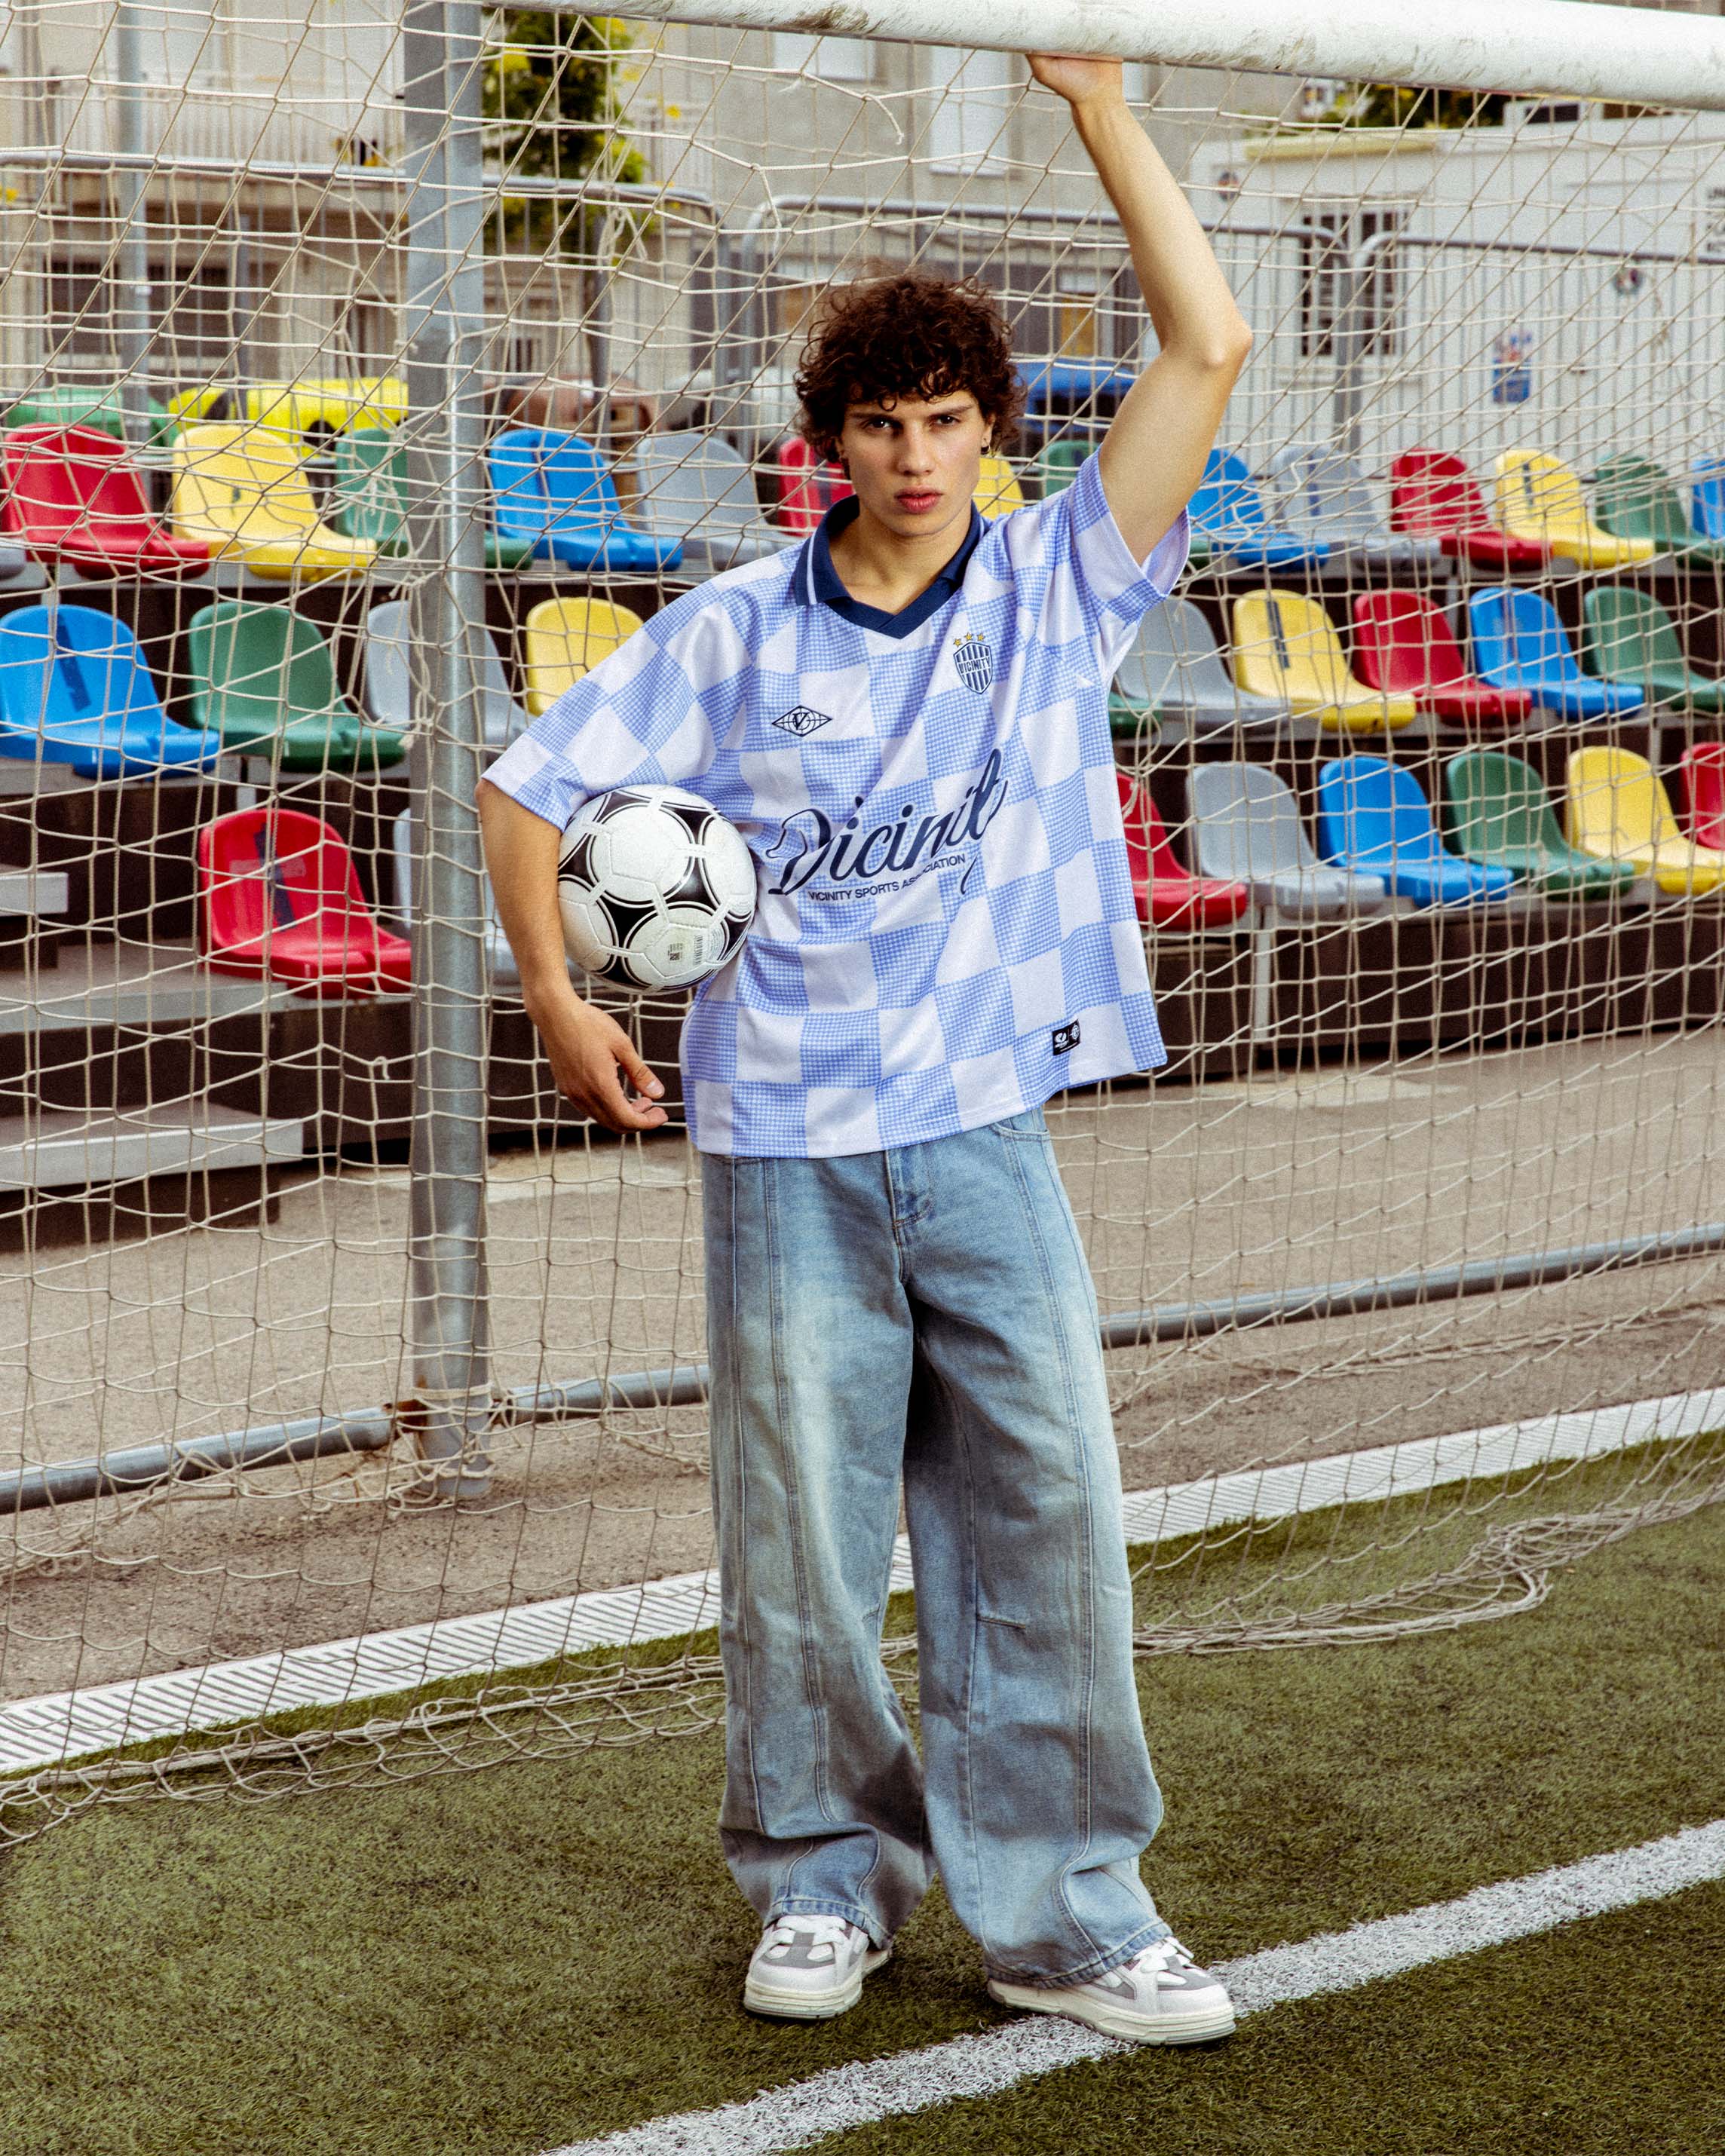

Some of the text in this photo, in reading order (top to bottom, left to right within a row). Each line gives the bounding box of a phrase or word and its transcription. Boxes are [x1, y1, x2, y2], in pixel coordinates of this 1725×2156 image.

[958, 657, 991, 674] VICINITY
[792, 712, 810, 730] V
[808, 890, 853, 902] VICINITY
[855, 881, 899, 899] SPORTS
